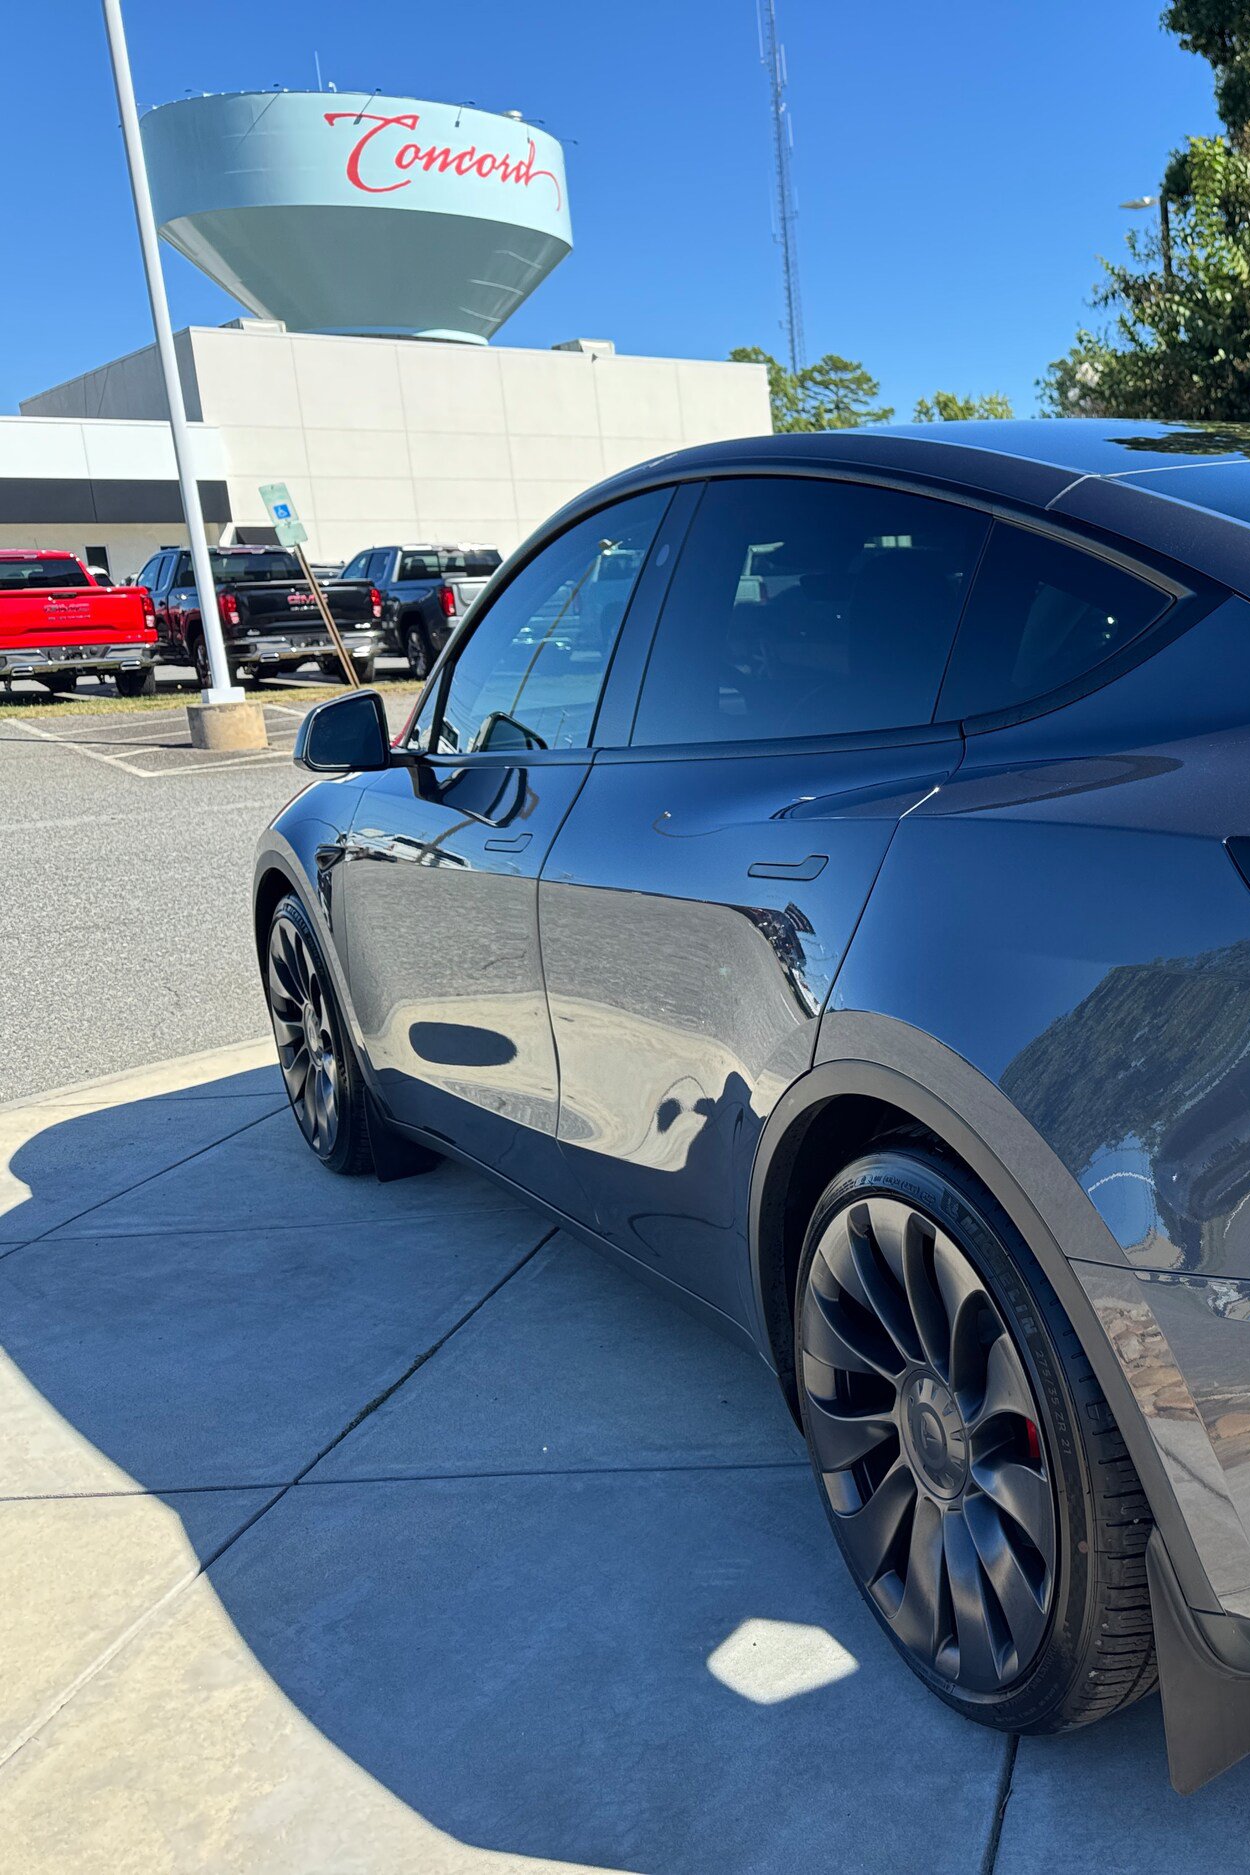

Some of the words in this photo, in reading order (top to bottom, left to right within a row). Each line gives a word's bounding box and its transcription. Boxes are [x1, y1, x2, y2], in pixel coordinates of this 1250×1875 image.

[324, 112, 562, 212] Concord
[960, 1215, 1038, 1334] MICHELIN
[1035, 1350, 1059, 1405] 275/35
